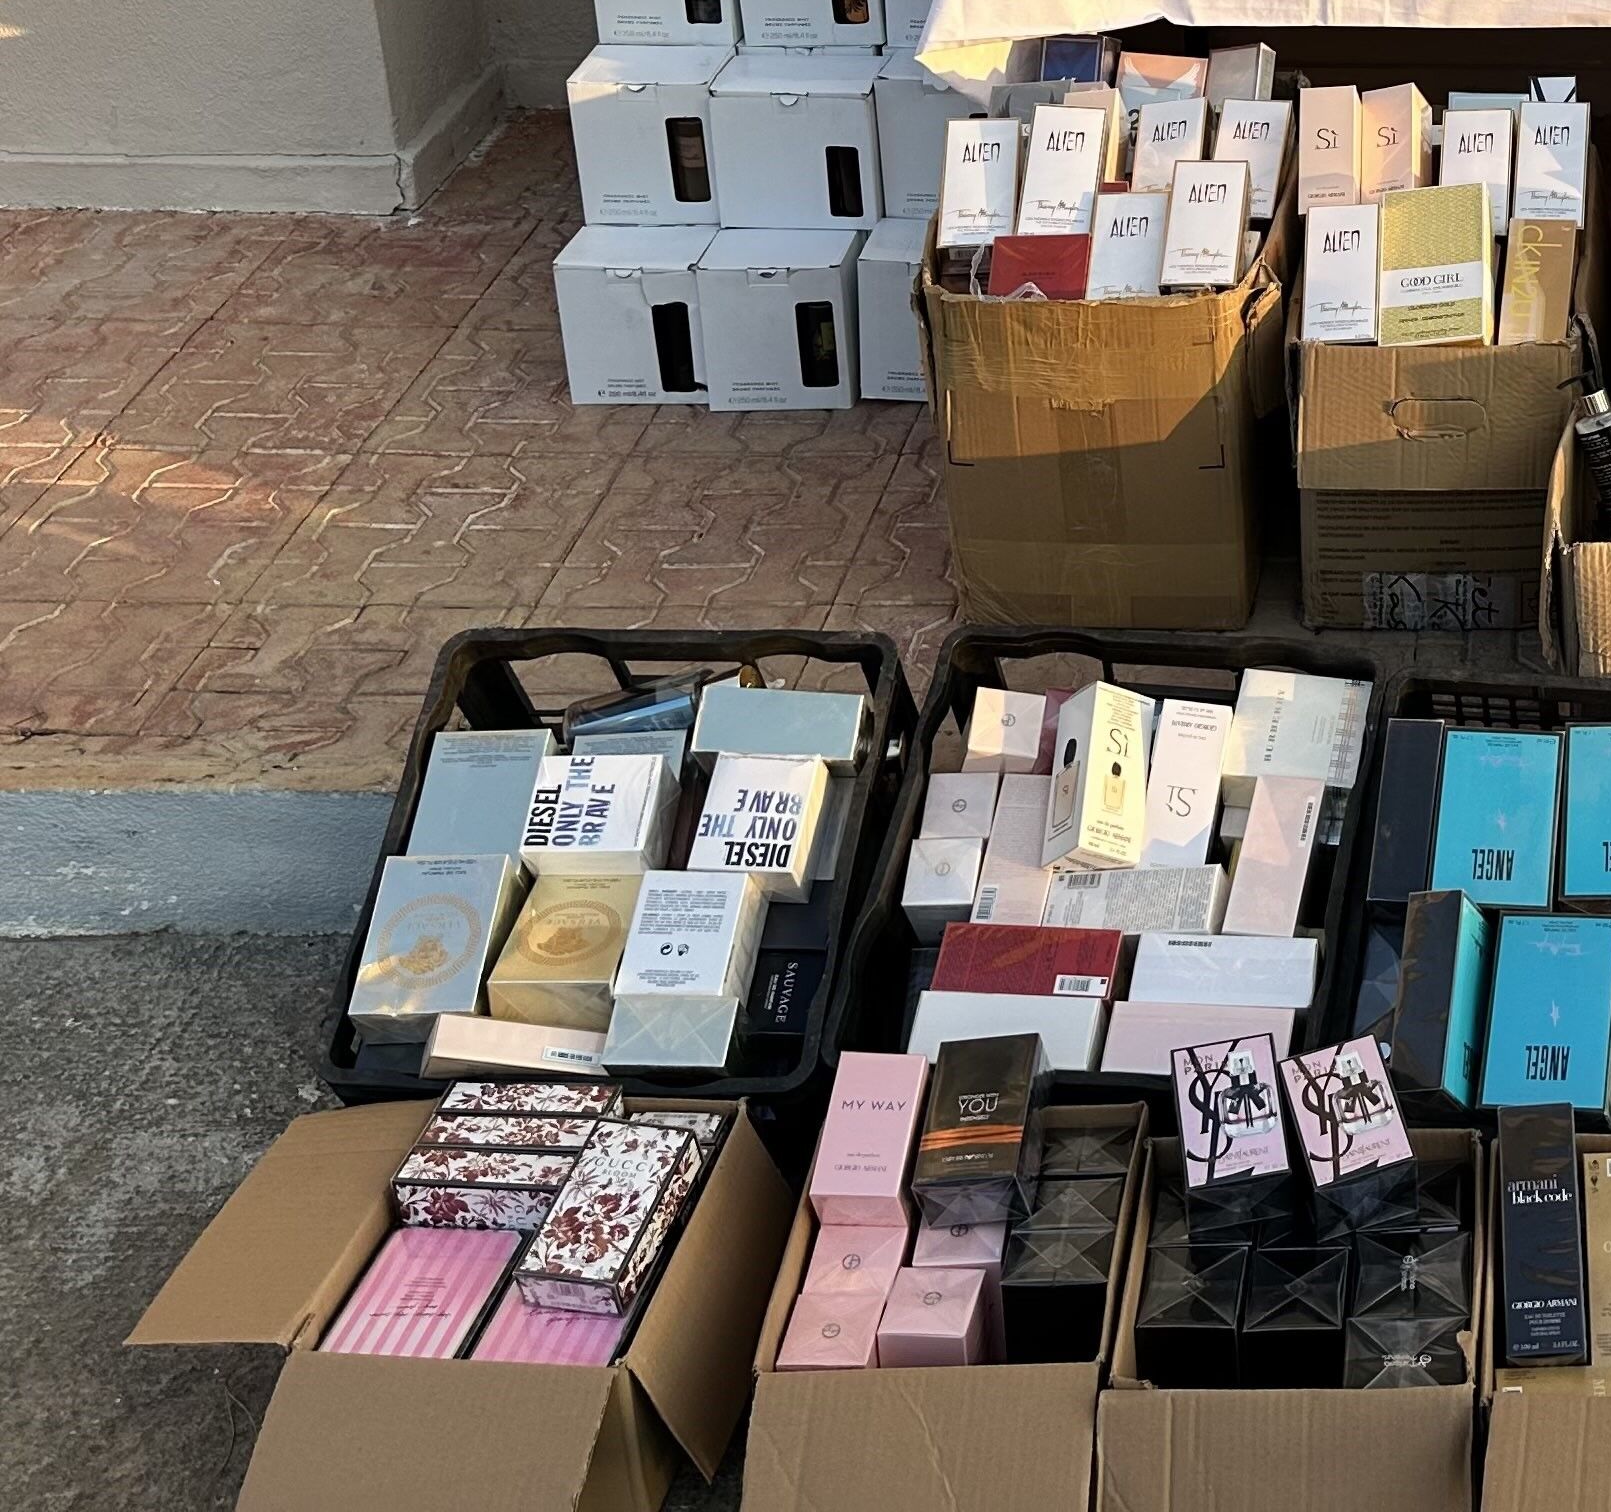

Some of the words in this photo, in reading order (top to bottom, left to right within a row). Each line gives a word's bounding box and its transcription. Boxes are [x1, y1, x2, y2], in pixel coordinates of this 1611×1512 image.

[1046, 130, 1085, 153] ALIEN
[1152, 119, 1188, 143] ALIEN
[1233, 120, 1270, 140] ALIEN
[1534, 125, 1570, 146] ALIEN
[961, 142, 1001, 163] ALIEN
[1458, 131, 1494, 155] ALIEN
[1188, 182, 1227, 204] ALIEN
[1110, 215, 1150, 238] ALIEN
[1322, 229, 1361, 254] ALIEN
[1400, 275, 1432, 288] GOOD
[1433, 272, 1465, 285] GIRL
[551, 792, 581, 847] ONLY
[566, 756, 595, 791] THE
[736, 788, 804, 816] BRAVE
[524, 784, 562, 847] DIESEL
[579, 783, 616, 847] BRAVE
[698, 813, 736, 839] THE
[745, 816, 797, 841] ONLY
[724, 841, 791, 868] DIESEL
[1471, 847, 1515, 882] ANGEL
[775, 961, 800, 1024] SAUVAGE
[1524, 1044, 1570, 1081] ANGEL
[841, 1100, 866, 1112] MY
[870, 1100, 908, 1112] WAY
[958, 1096, 999, 1114] YOU
[593, 1155, 655, 1173] GUCCI
[1507, 1173, 1558, 1193] armani
[1511, 1188, 1543, 1205] black
[1544, 1188, 1573, 1203] code
